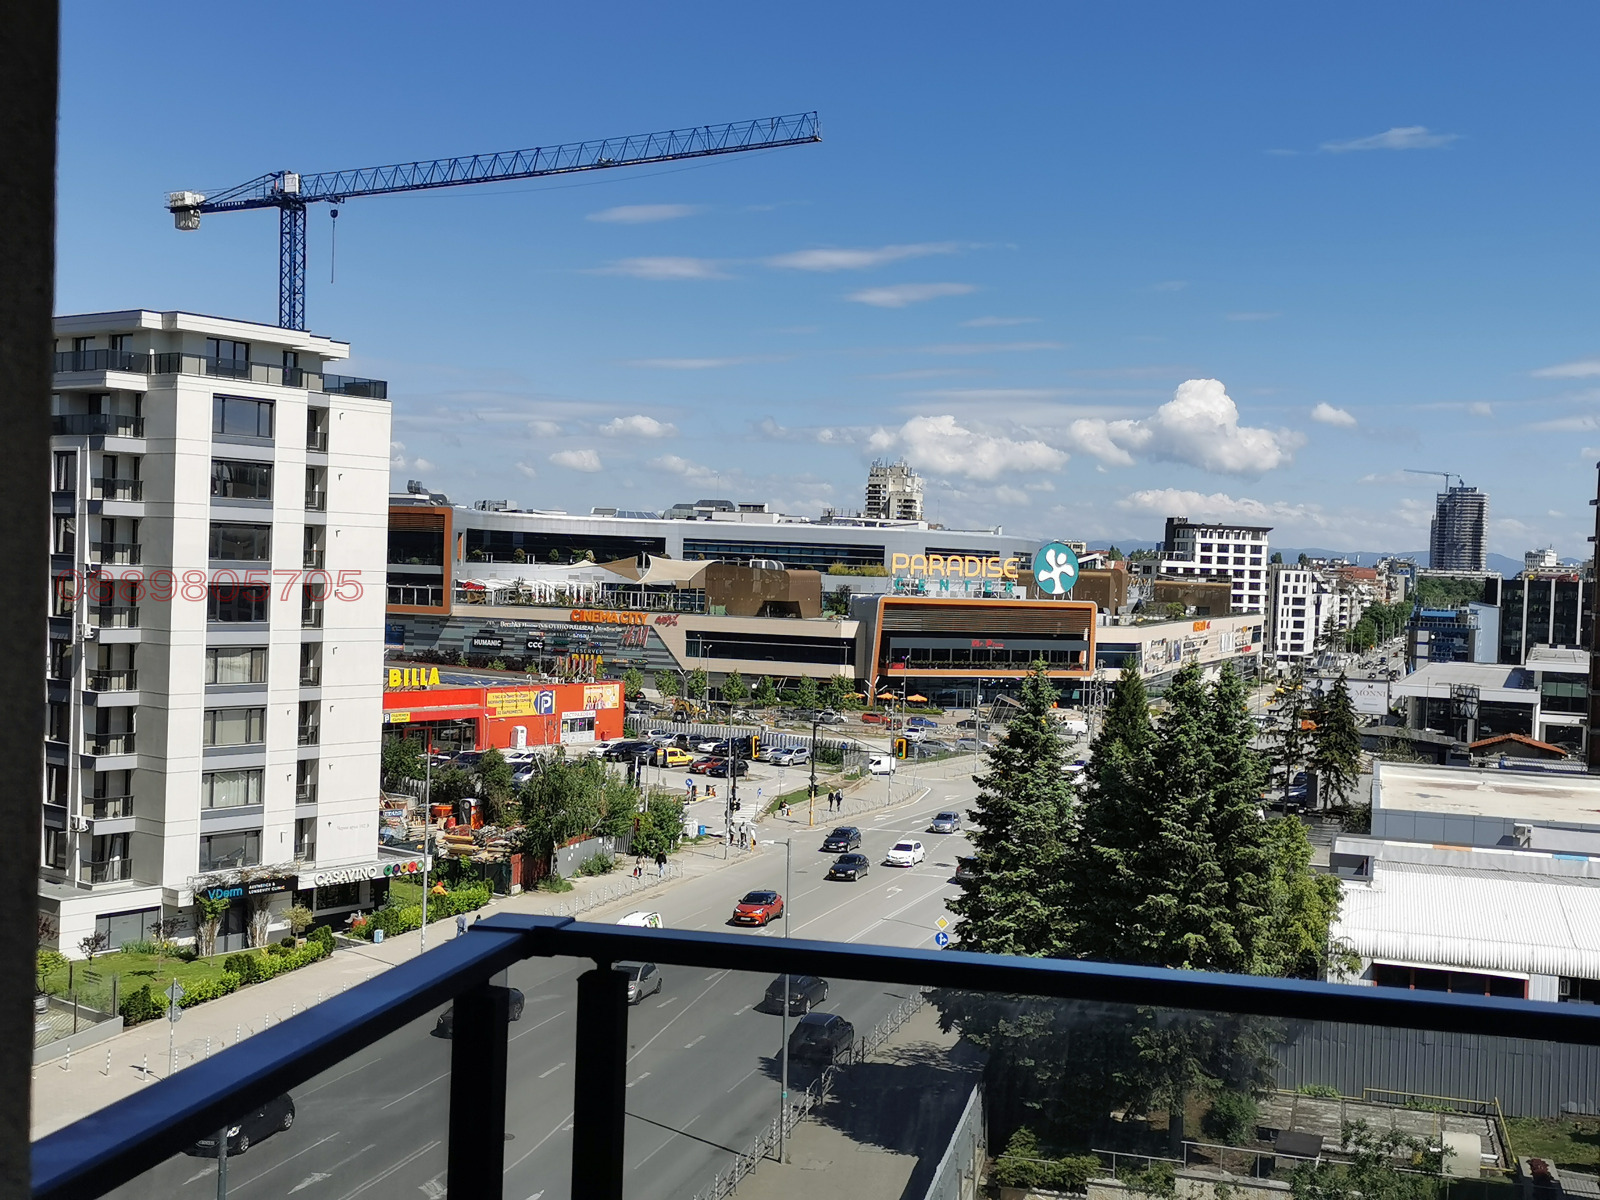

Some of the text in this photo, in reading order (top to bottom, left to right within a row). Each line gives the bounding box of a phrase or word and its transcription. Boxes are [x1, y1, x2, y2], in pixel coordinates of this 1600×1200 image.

[892, 553, 1019, 578] PARADISE
[895, 578, 1013, 593] CENTER
[571, 609, 650, 625] CINEMA CITY
[474, 638, 502, 647] HUMANIC
[388, 667, 440, 687] BILLA
[315, 866, 378, 885] CASAVINO
